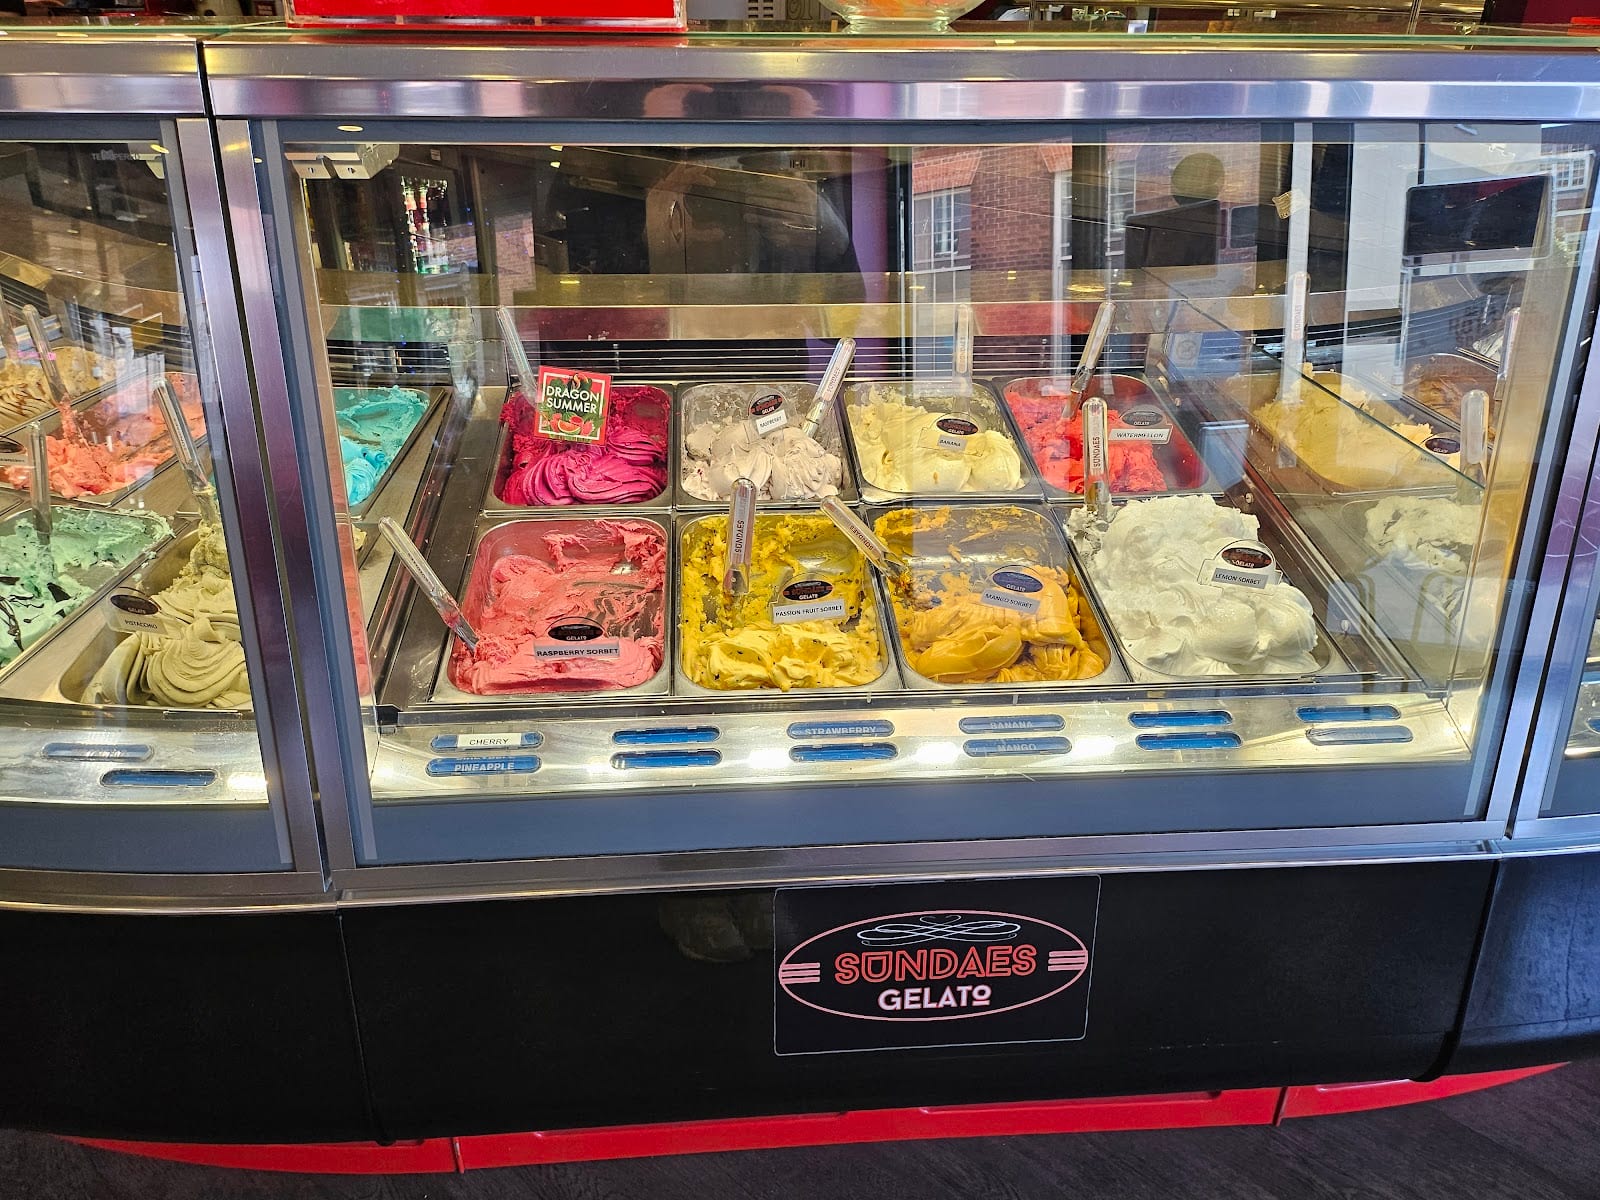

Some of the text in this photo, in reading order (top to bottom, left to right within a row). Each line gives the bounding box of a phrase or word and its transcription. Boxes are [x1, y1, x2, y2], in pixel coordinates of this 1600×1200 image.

[546, 385, 600, 402] DRAGON
[546, 397, 597, 414] SUMMER
[939, 439, 962, 448] BANANA
[1092, 436, 1101, 468] SUNDAES
[1215, 573, 1262, 586] LEMON SORBET
[985, 593, 1033, 609] MANGO SORBET
[802, 607, 819, 615] FRUIT
[820, 604, 843, 612] SORBET
[536, 649, 585, 657] RASPBERRY
[805, 726, 876, 735] STRAWBERRY
[990, 720, 1034, 730] BANANA
[469, 738, 509, 746] CHERRY
[997, 743, 1037, 752] MANGO
[454, 762, 515, 772] PINEAPPLE
[834, 943, 1038, 985] SUNDAES
[877, 984, 992, 1011] GELATO
